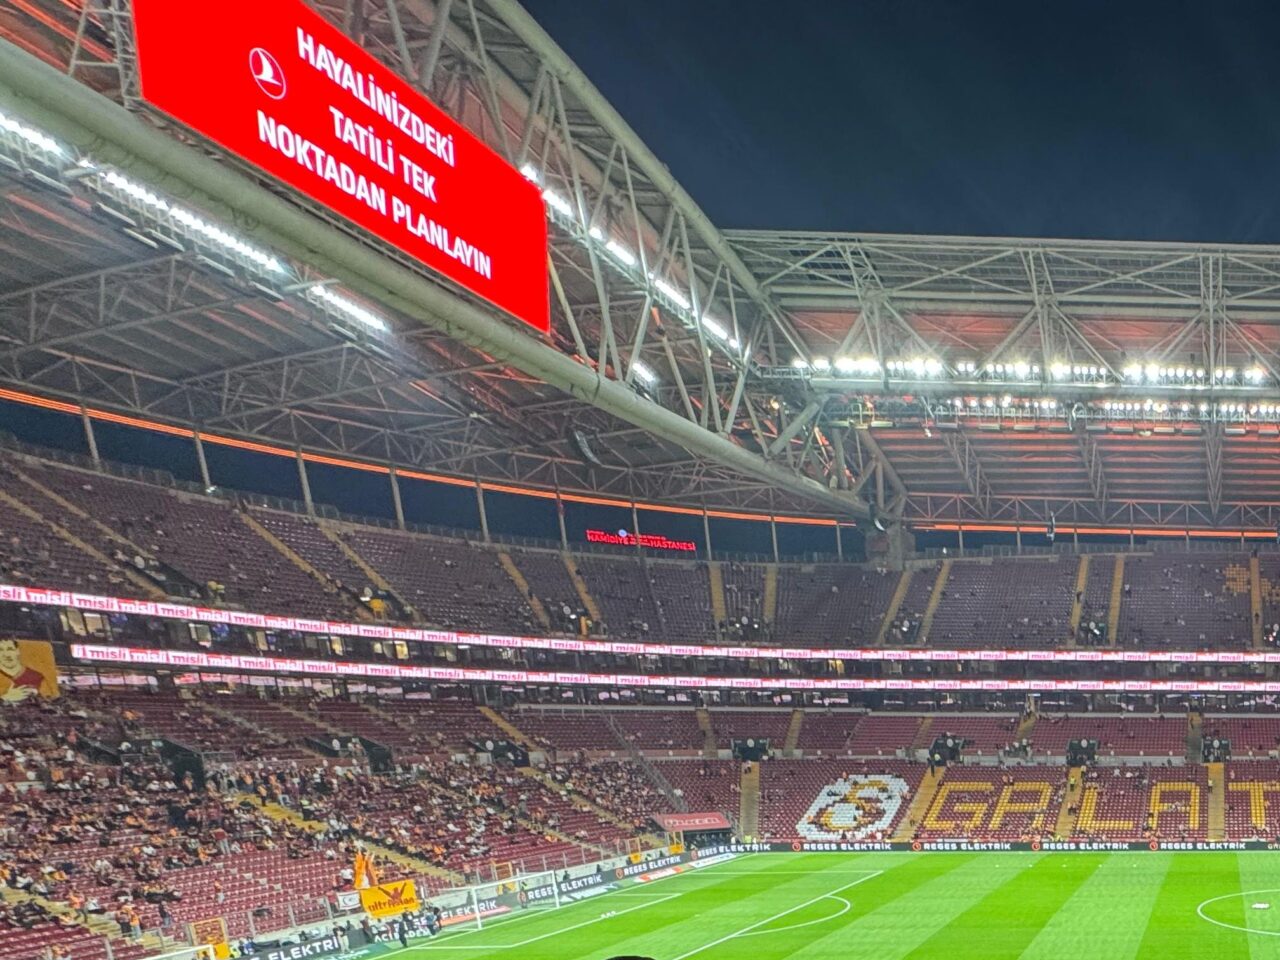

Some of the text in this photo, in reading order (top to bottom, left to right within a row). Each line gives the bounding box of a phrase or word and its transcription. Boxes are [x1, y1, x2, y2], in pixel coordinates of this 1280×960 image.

[297, 26, 455, 168] HAYALİNİZDEKİ
[329, 105, 437, 203] TATİLİ TEK
[257, 109, 491, 280] NOKTADAN PLANLAYIN
[76, 597, 114, 610] misli
[161, 606, 192, 617] misli
[234, 614, 262, 625] misli
[90, 649, 127, 661] misli
[173, 653, 207, 665] misli
[243, 659, 271, 670] misli
[1160, 842, 1193, 850] REGES
